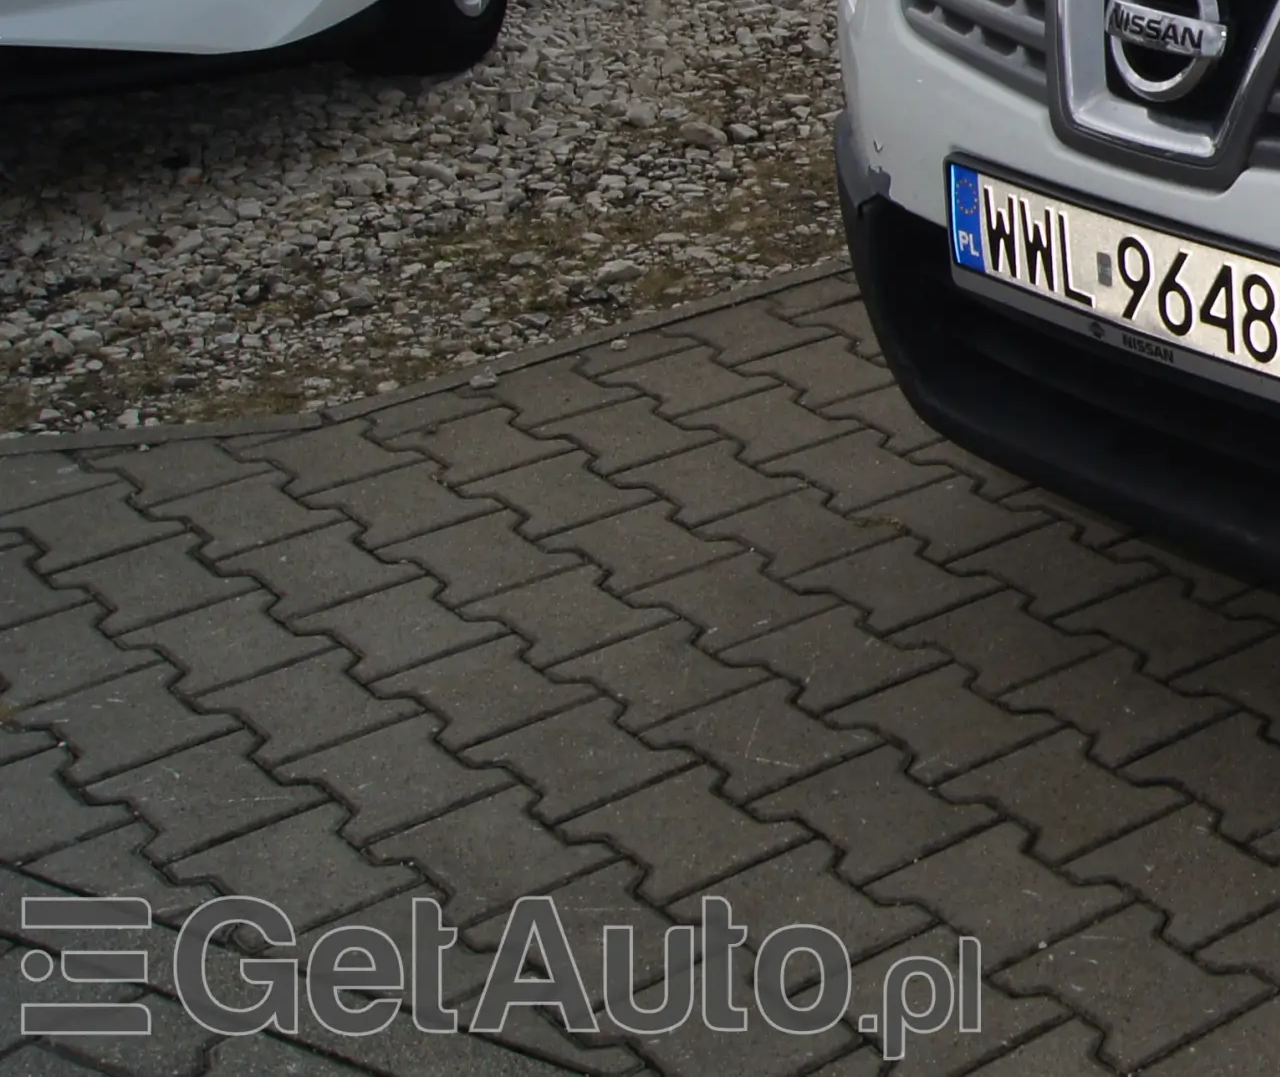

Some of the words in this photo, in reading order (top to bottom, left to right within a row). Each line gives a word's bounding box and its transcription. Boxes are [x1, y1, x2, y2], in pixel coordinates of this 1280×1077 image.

[1108, 8, 1203, 49] NISSAN
[959, 230, 980, 257] PL
[984, 185, 1095, 308] WWL
[1121, 334, 1175, 363] NISSAN
